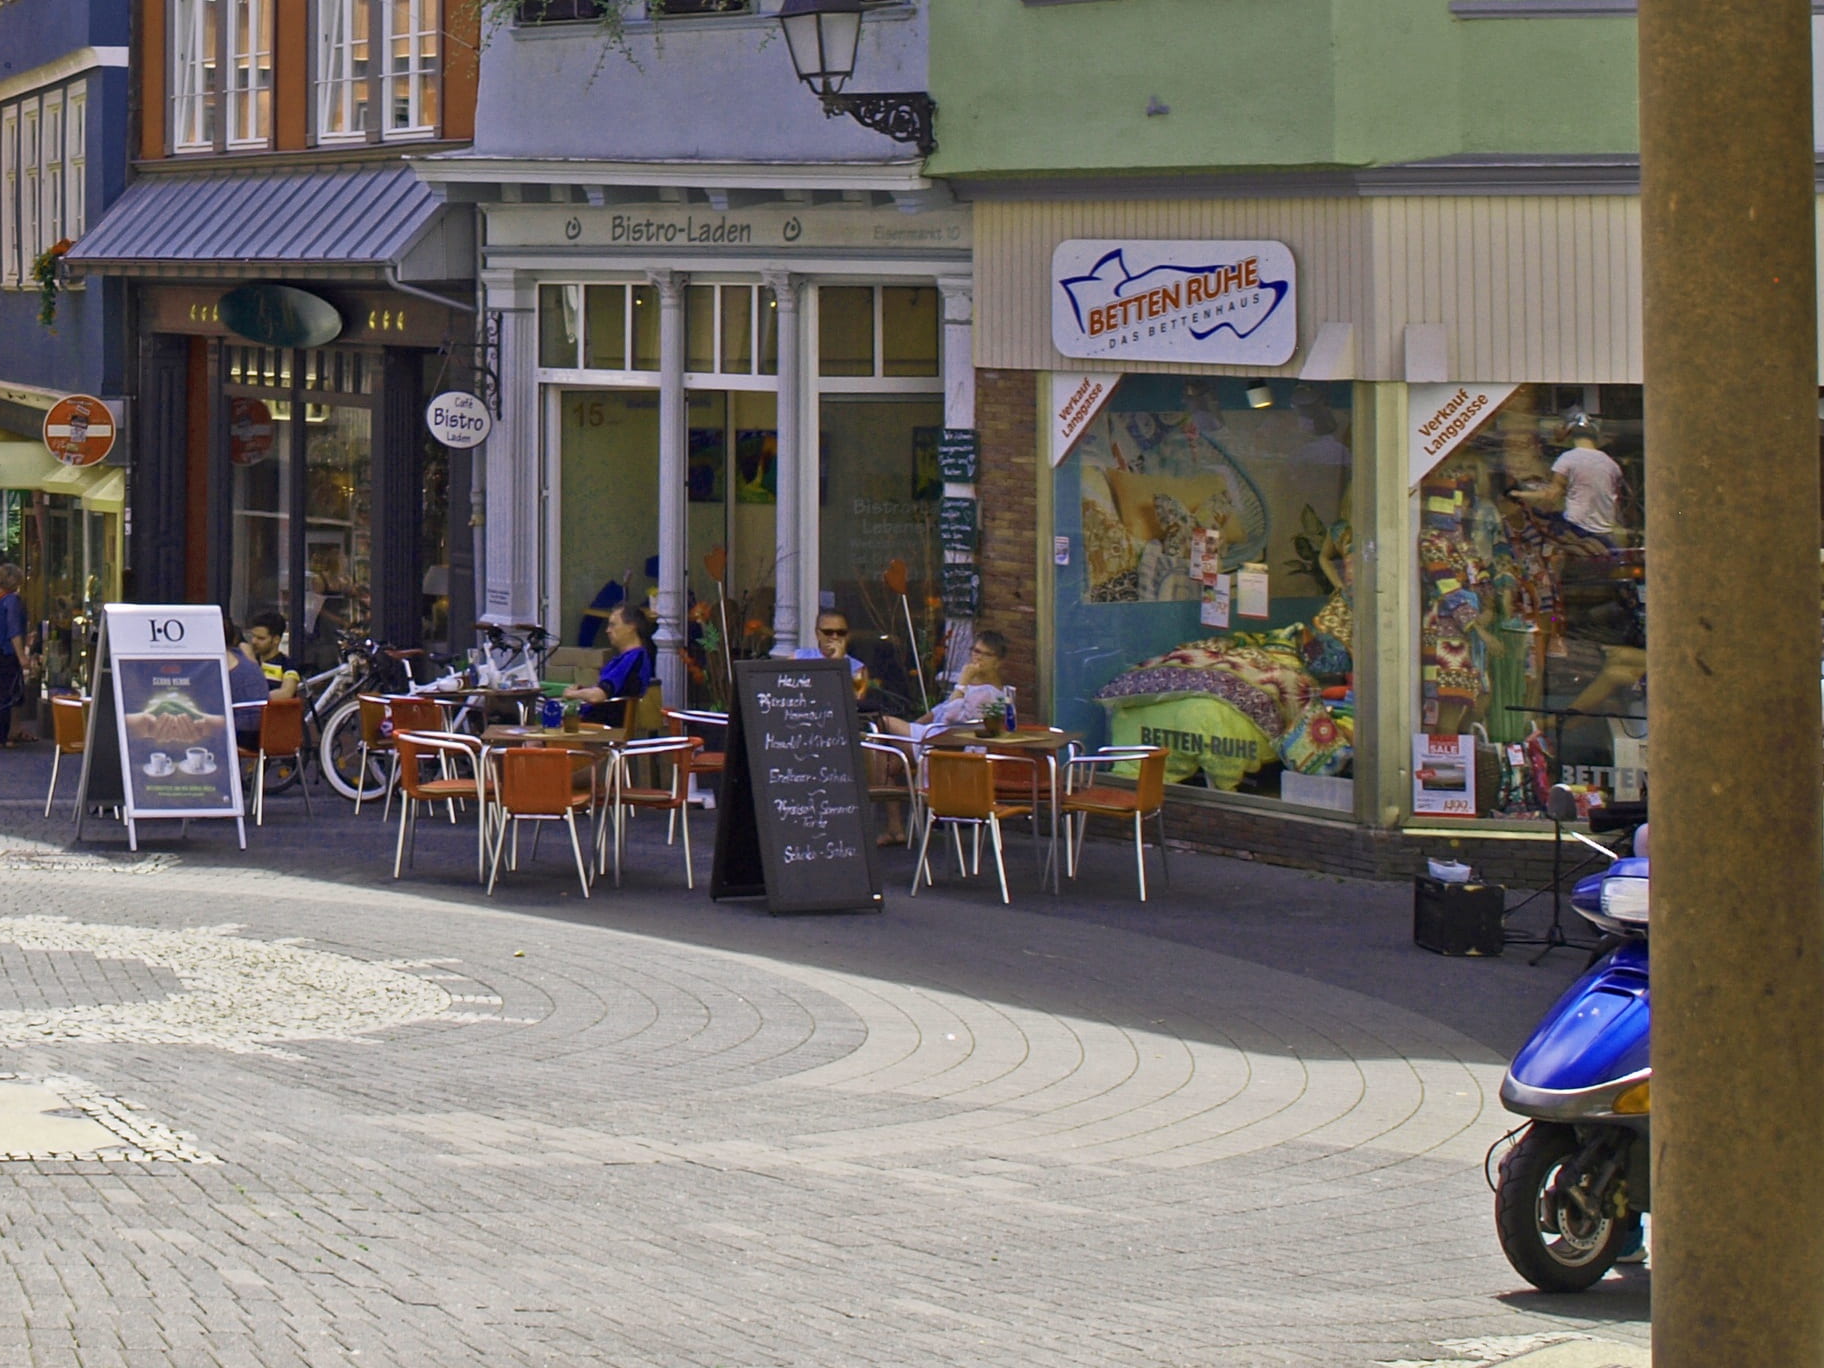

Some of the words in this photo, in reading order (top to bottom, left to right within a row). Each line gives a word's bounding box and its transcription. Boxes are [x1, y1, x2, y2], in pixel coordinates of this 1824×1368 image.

[610, 215, 752, 243] Bistro-Laden
[1089, 283, 1181, 336] BETTEN
[1186, 257, 1258, 307] RUHE
[1148, 293, 1260, 338] BETTENHAUS
[434, 407, 484, 431] Bistro
[573, 401, 605, 428] 15
[1059, 376, 1091, 421] Verkauf
[1062, 383, 1103, 438] Langgasse
[1418, 387, 1470, 437] Verkauf
[1423, 394, 1489, 456] Langgasse
[1141, 726, 1258, 760] BETTEN-RUHE
[1429, 744, 1458, 753] SALE
